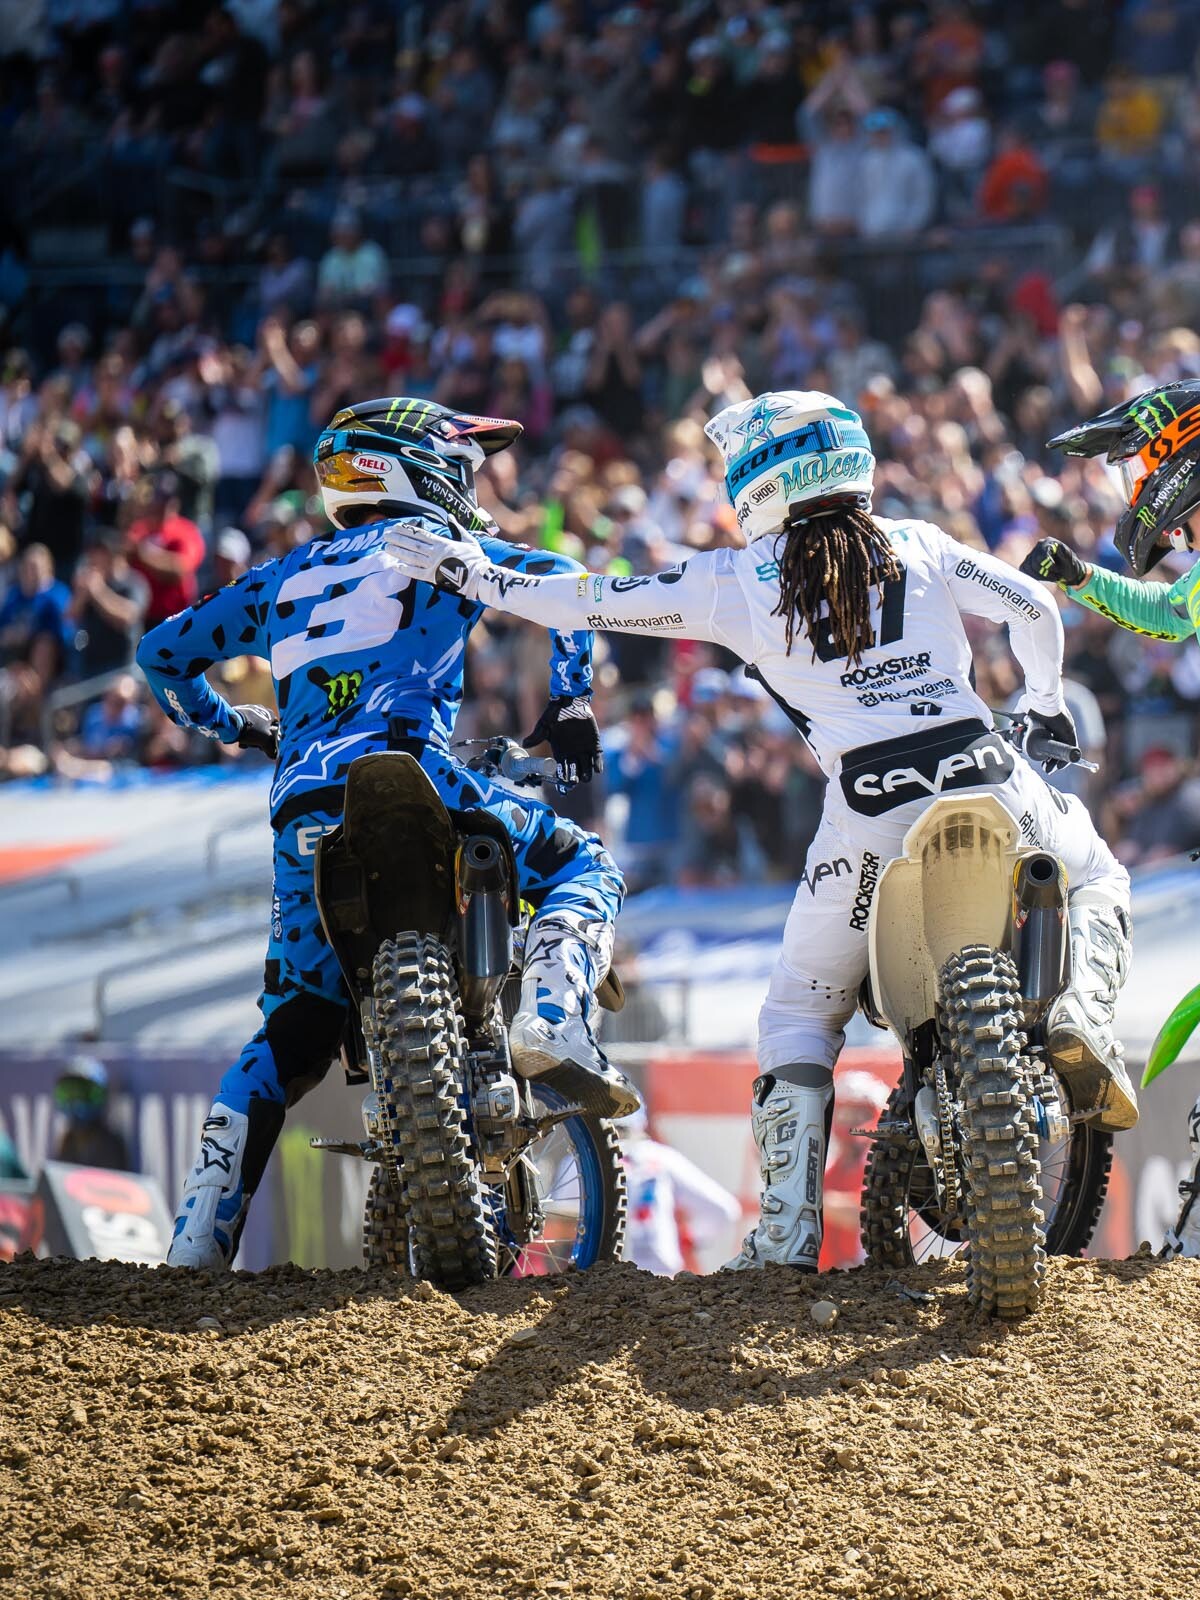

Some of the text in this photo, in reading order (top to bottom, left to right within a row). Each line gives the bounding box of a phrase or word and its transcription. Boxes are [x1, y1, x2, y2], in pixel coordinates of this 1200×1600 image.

[358, 457, 387, 472] BELL
[730, 432, 816, 483] SCOTT
[421, 475, 472, 518] MONSTER
[751, 482, 778, 504] SHOEI
[1151, 458, 1197, 510] MONSTER
[271, 551, 412, 681] 3
[606, 612, 684, 629] Husqvarna
[972, 570, 1042, 621] Husqvarna
[840, 651, 932, 688] ROCKSTAR
[853, 745, 1004, 797] seven
[849, 850, 881, 932] ROCKSTAR
